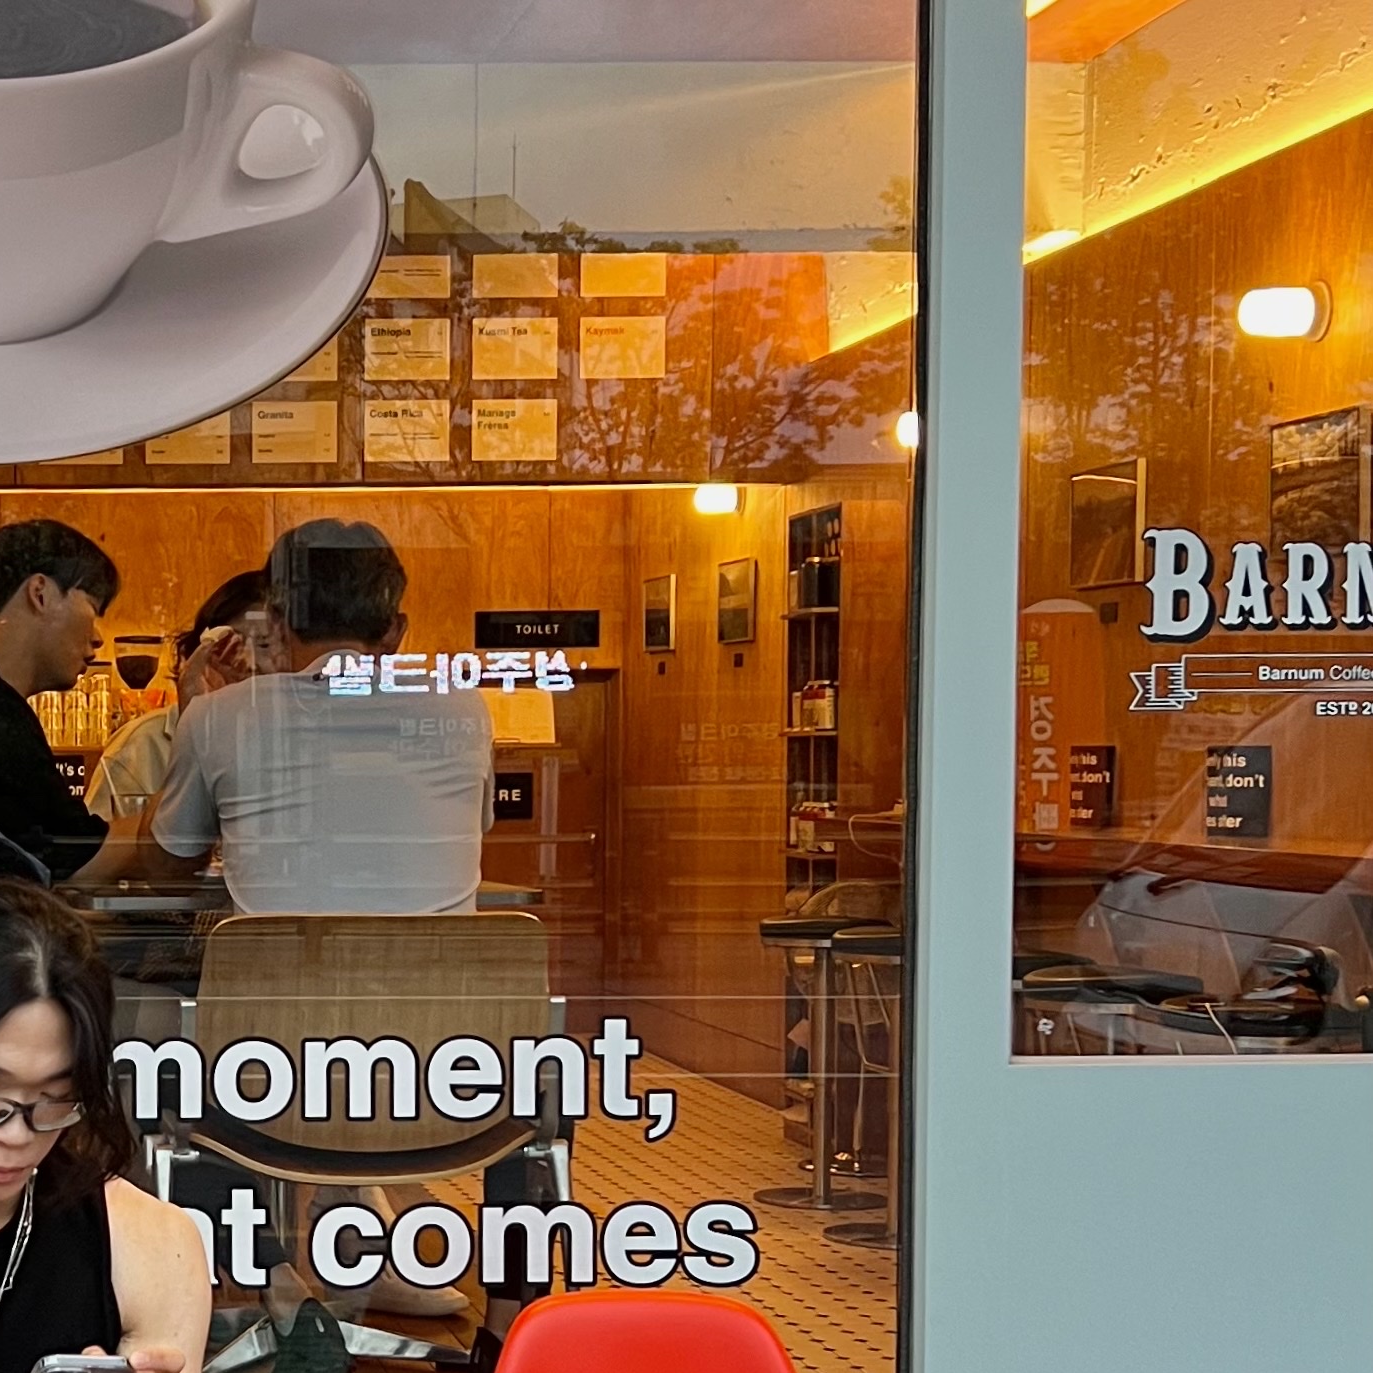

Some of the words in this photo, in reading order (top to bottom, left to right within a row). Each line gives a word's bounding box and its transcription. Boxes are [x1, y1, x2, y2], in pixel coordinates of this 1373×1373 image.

[370, 327, 411, 338] Ethiopia
[369, 409, 398, 418] Costa
[515, 624, 560, 635] TOILET
[1258, 665, 1324, 681] Barnum
[1329, 664, 1373, 681] Coffe
[1361, 701, 1373, 716] 2
[1226, 773, 1265, 788] don't
[113, 1015, 676, 1141] moment,
[311, 1199, 758, 1288] comes
